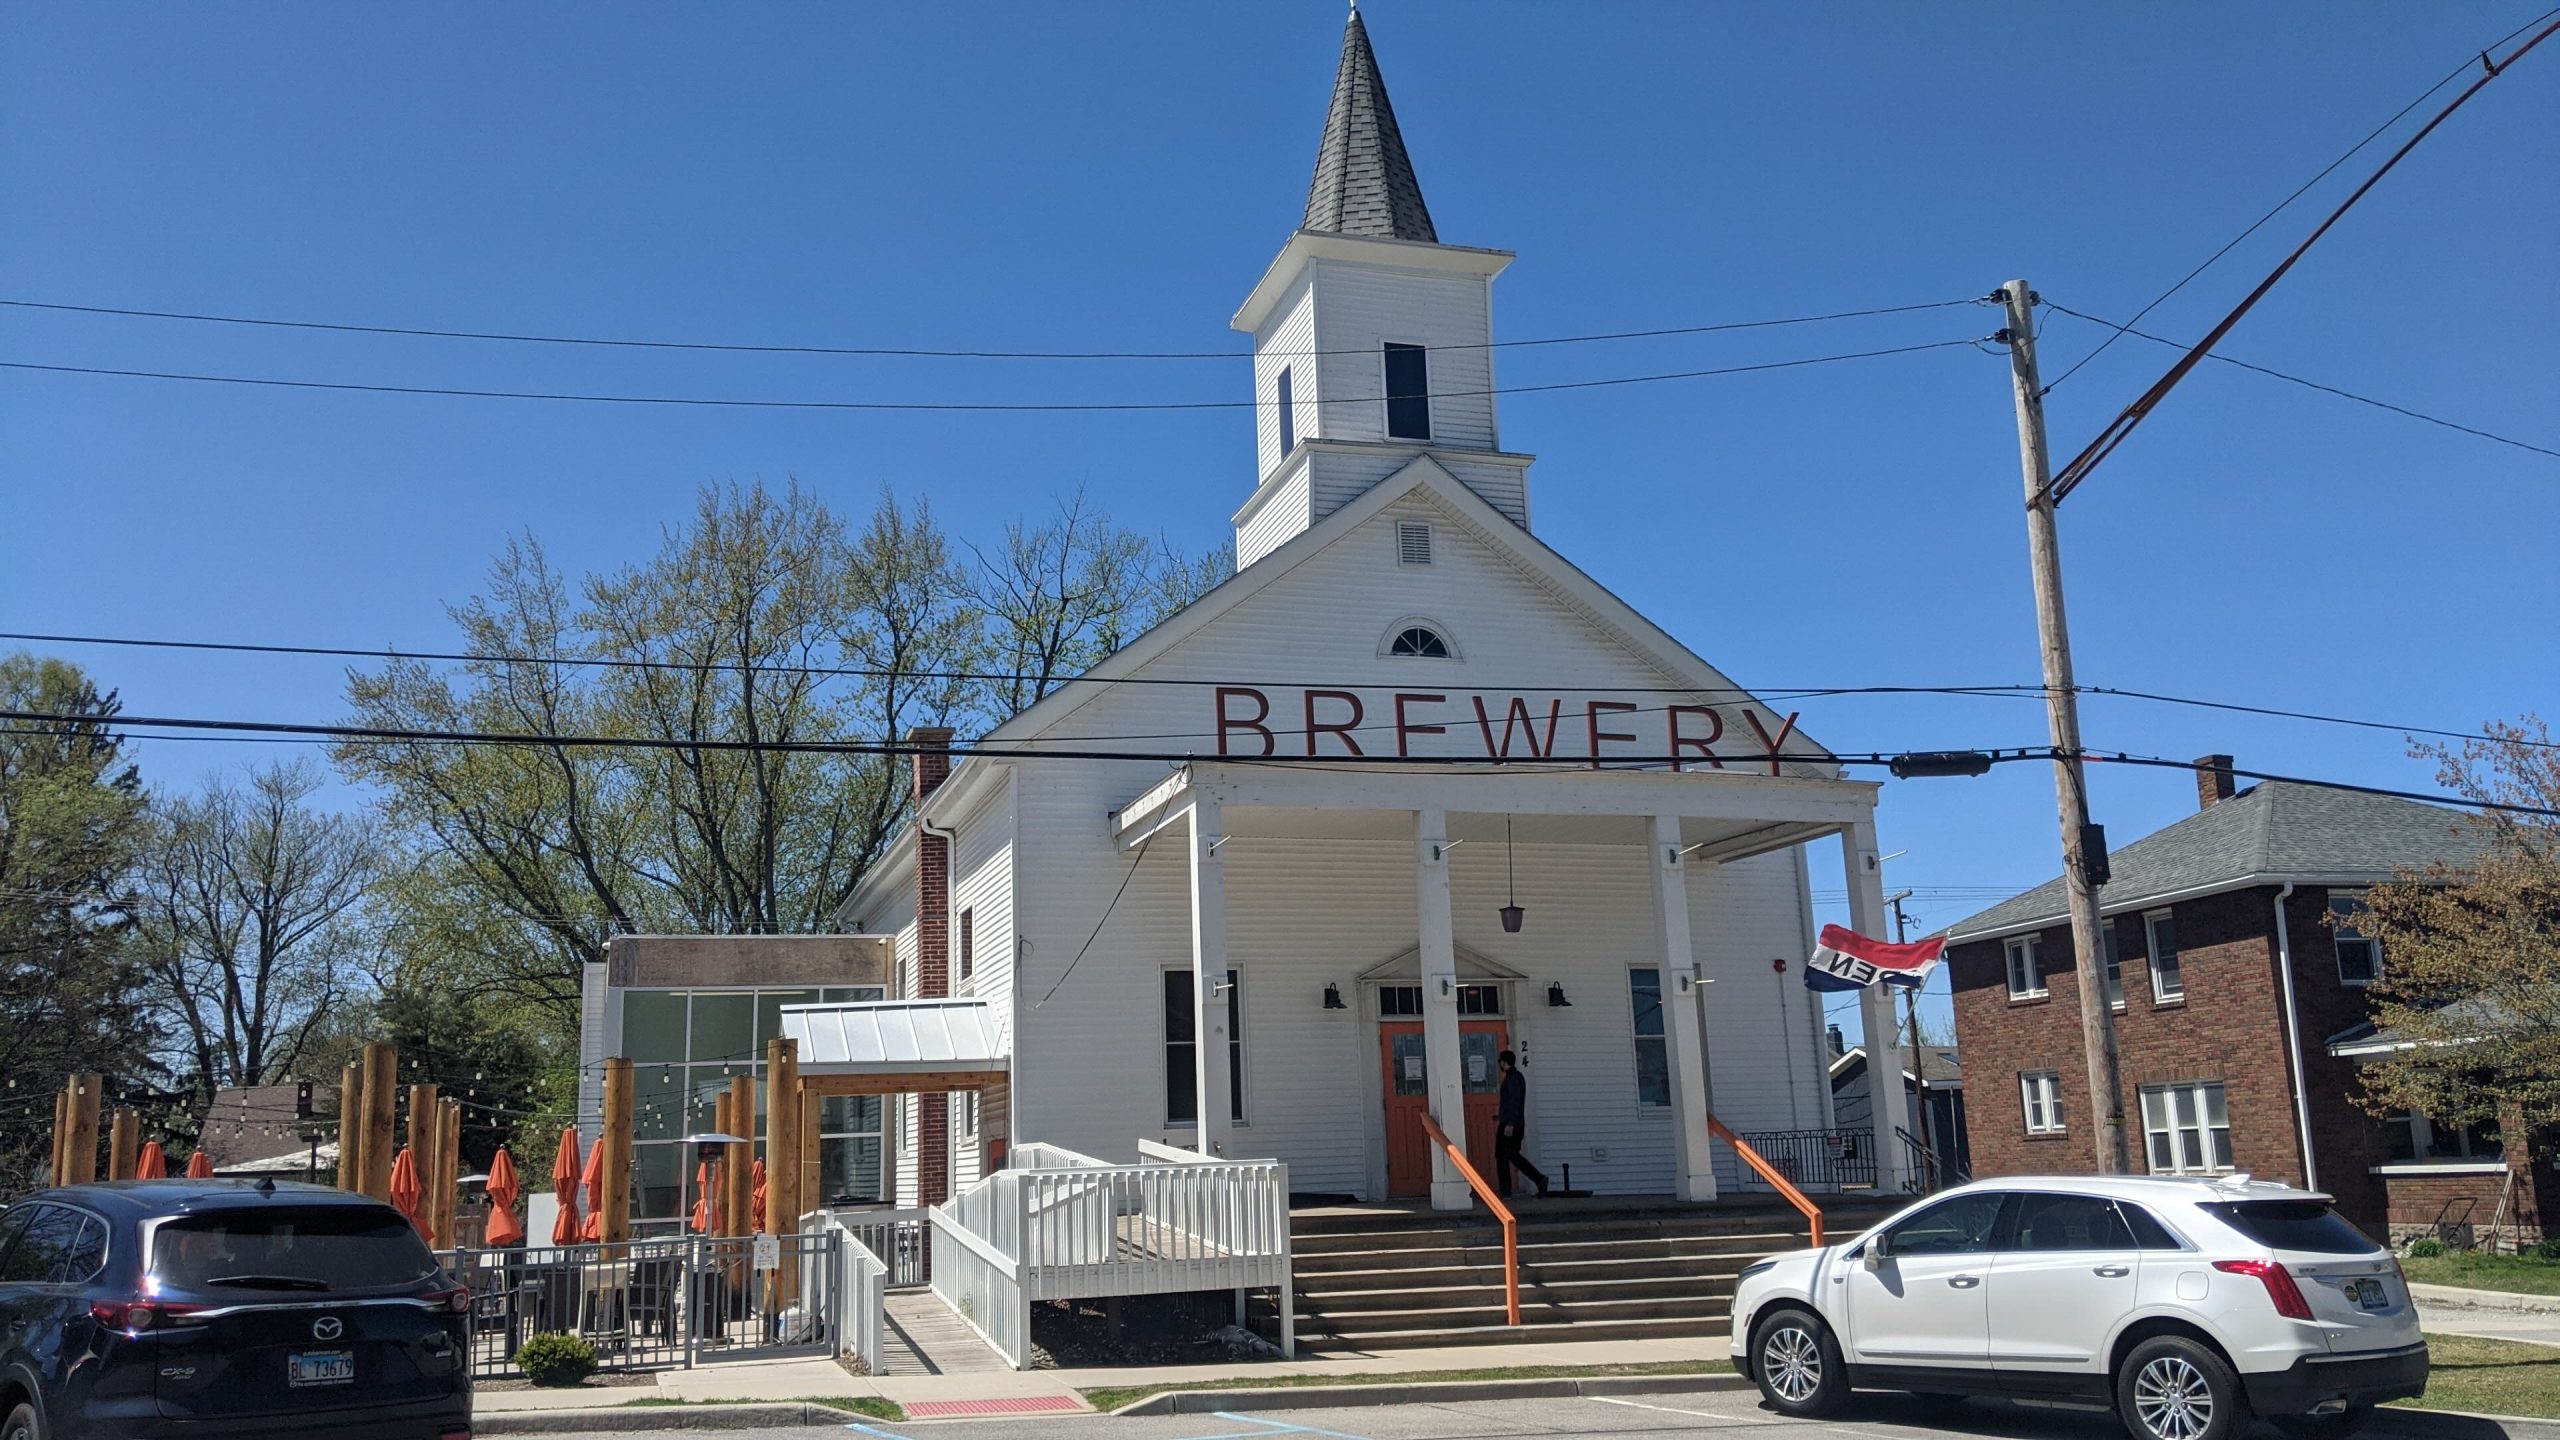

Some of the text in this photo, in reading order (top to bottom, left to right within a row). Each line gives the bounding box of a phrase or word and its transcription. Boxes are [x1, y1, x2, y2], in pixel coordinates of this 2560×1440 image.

[1214, 686, 1801, 777] BREWERY
[160, 1367, 196, 1376] CX-9
[291, 1359, 353, 1379] BL 73679
